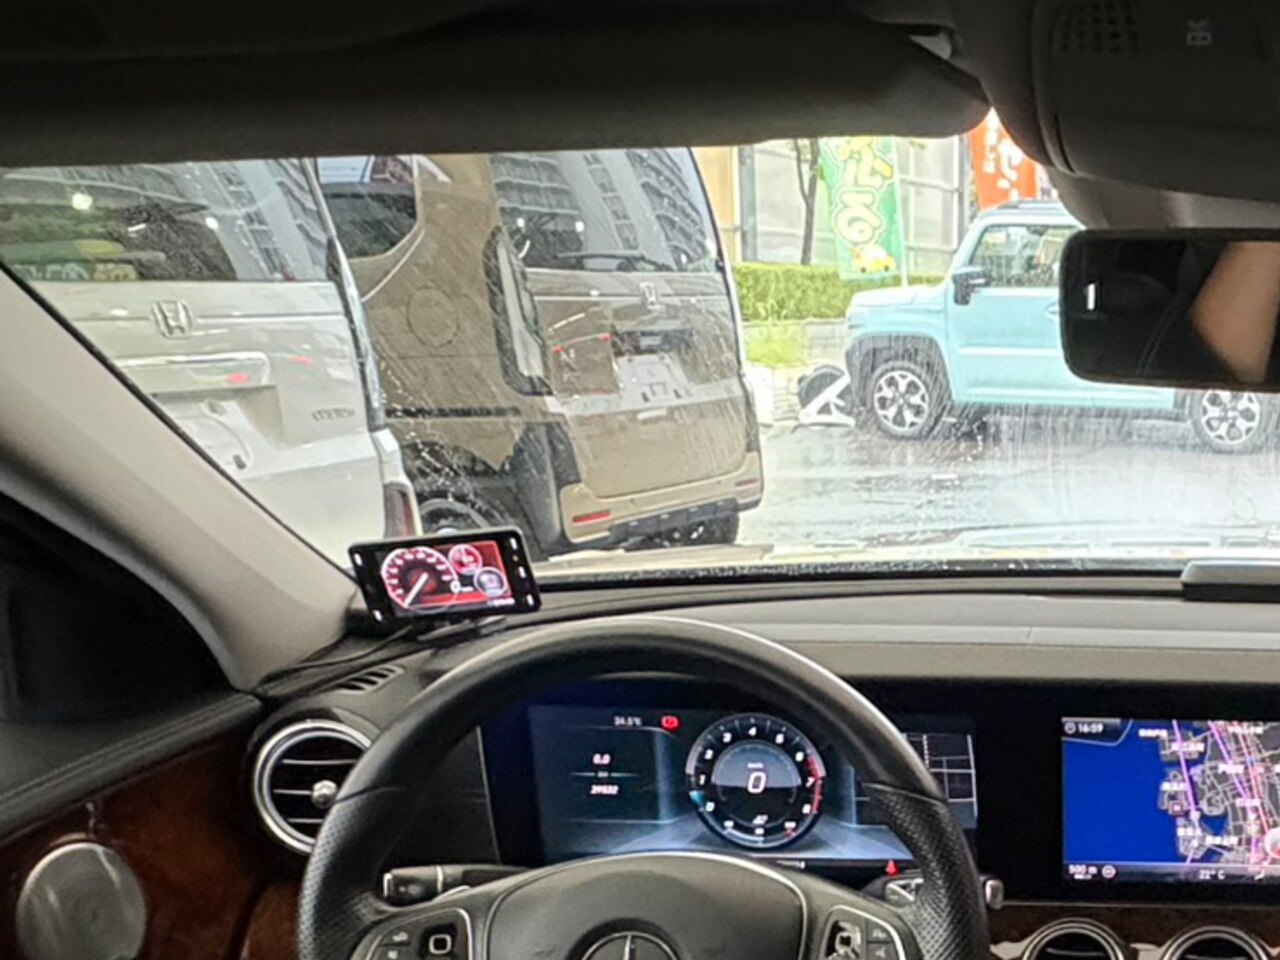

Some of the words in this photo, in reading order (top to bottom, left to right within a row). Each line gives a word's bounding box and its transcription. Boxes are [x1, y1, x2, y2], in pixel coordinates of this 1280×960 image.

[748, 727, 757, 736] 4
[699, 774, 706, 785] 1
[747, 772, 767, 793] 0
[805, 777, 815, 787] 7
[705, 802, 715, 811] 0
